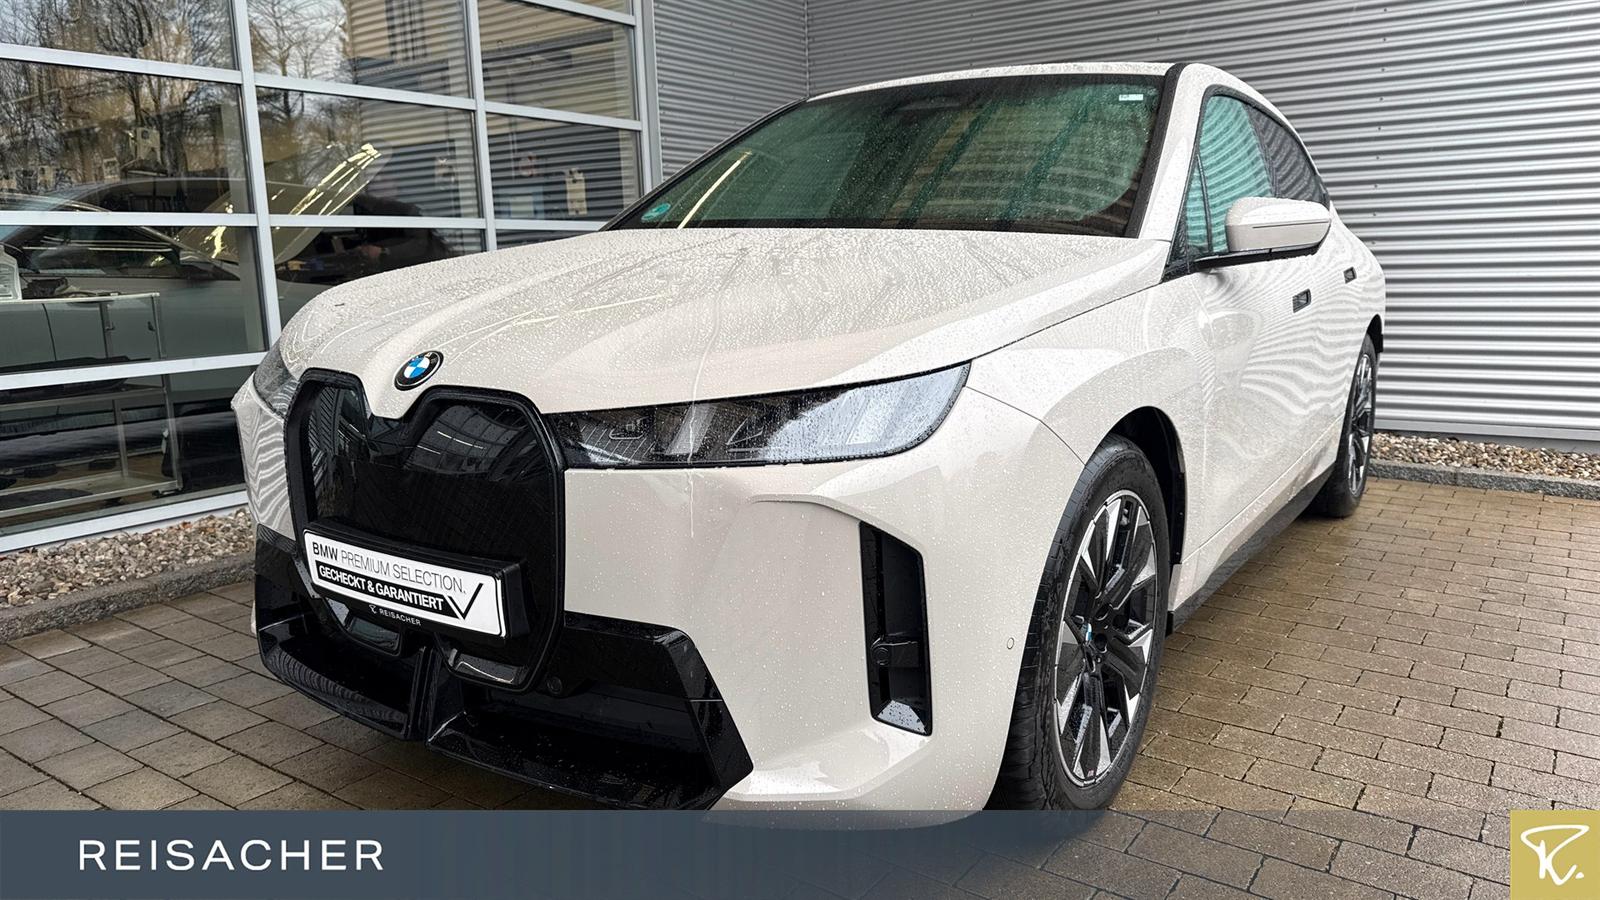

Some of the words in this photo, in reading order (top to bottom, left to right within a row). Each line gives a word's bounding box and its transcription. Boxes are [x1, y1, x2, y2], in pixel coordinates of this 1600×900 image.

[312, 541, 338, 561] BMW
[341, 550, 391, 576] PREMIUM
[393, 565, 467, 594] SELECTION.
[319, 565, 367, 592] GECHECKT
[367, 581, 375, 593] &
[375, 582, 444, 611] GARANTIERT
[379, 608, 421, 626] REISACHER
